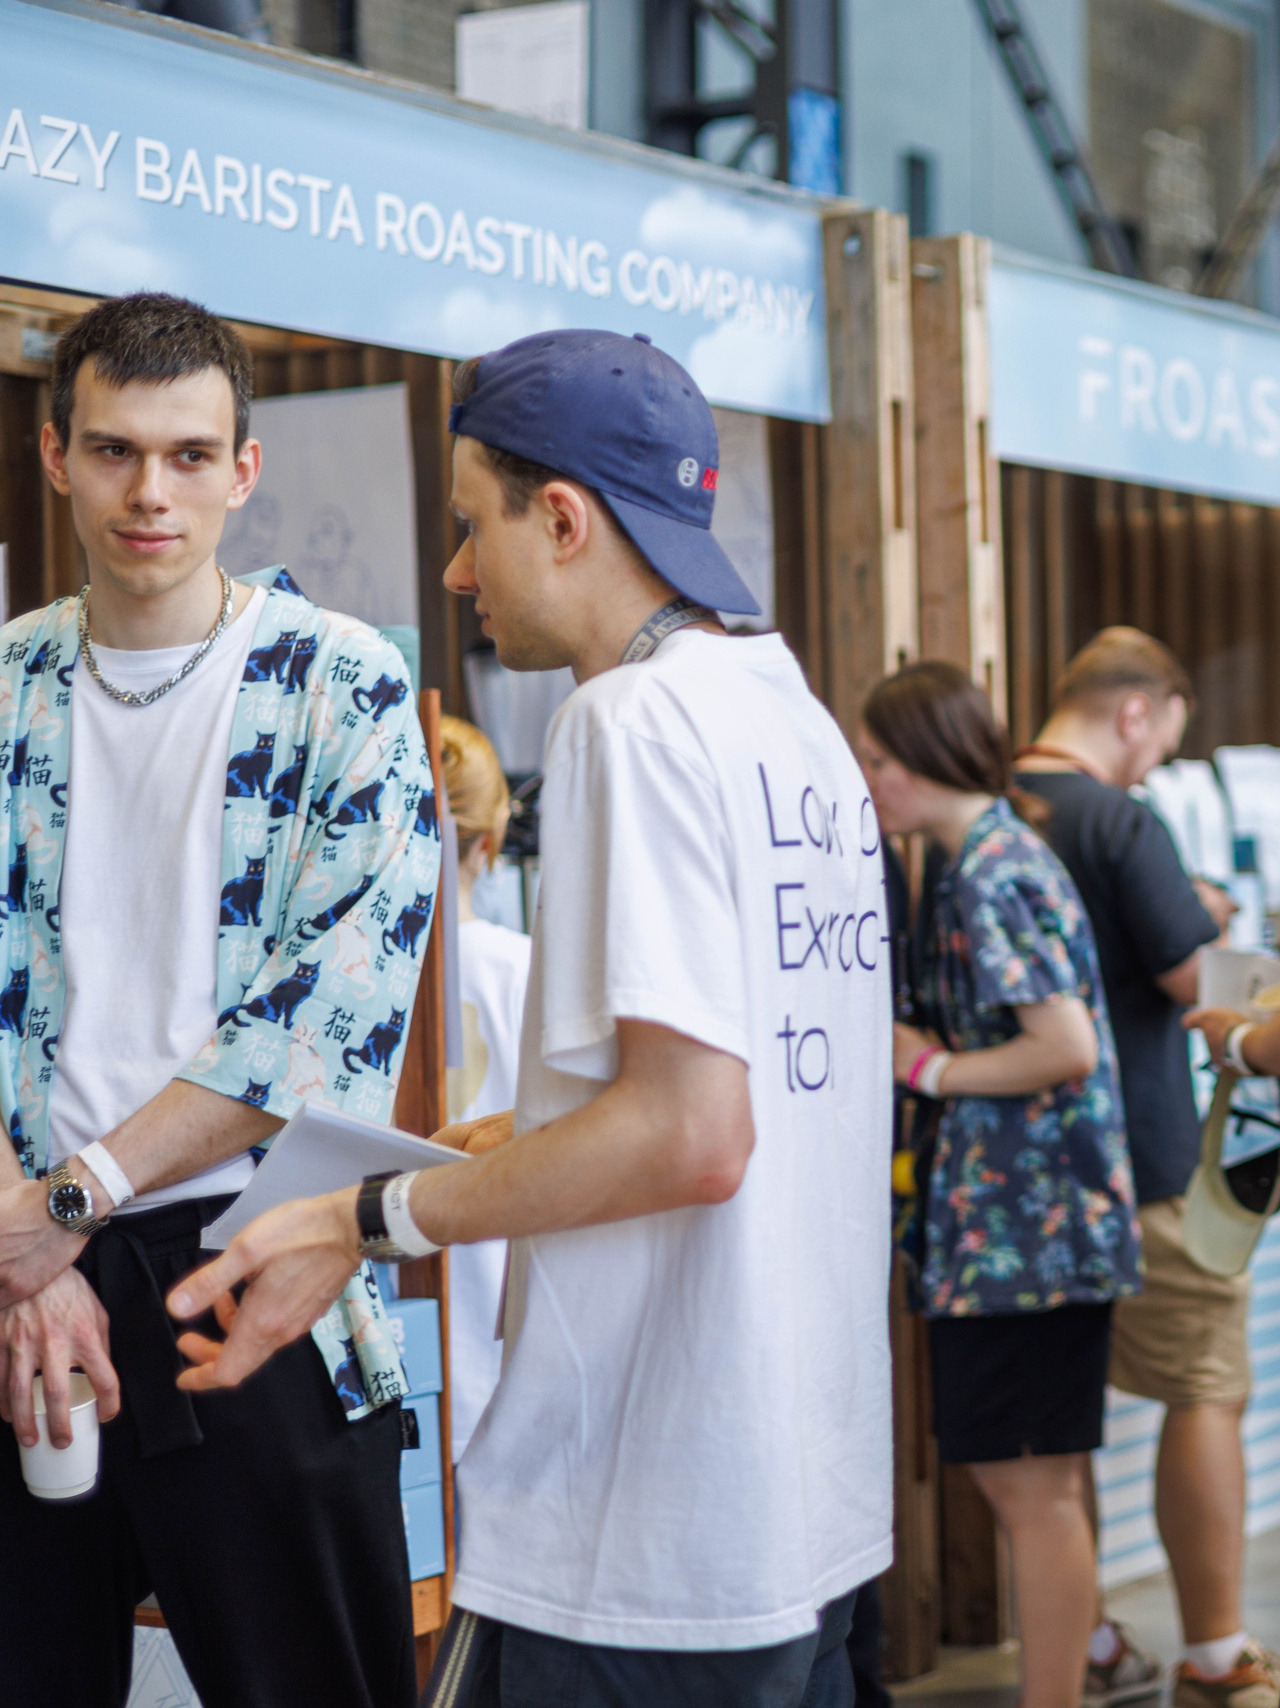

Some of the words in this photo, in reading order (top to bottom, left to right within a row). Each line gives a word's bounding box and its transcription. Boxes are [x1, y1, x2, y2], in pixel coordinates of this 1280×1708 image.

[0, 108, 121, 190] AZY
[136, 136, 366, 248] BARISTA
[376, 192, 612, 298] ROASTING
[618, 249, 815, 336] COMPANY
[323, 1004, 357, 1045] 猫
